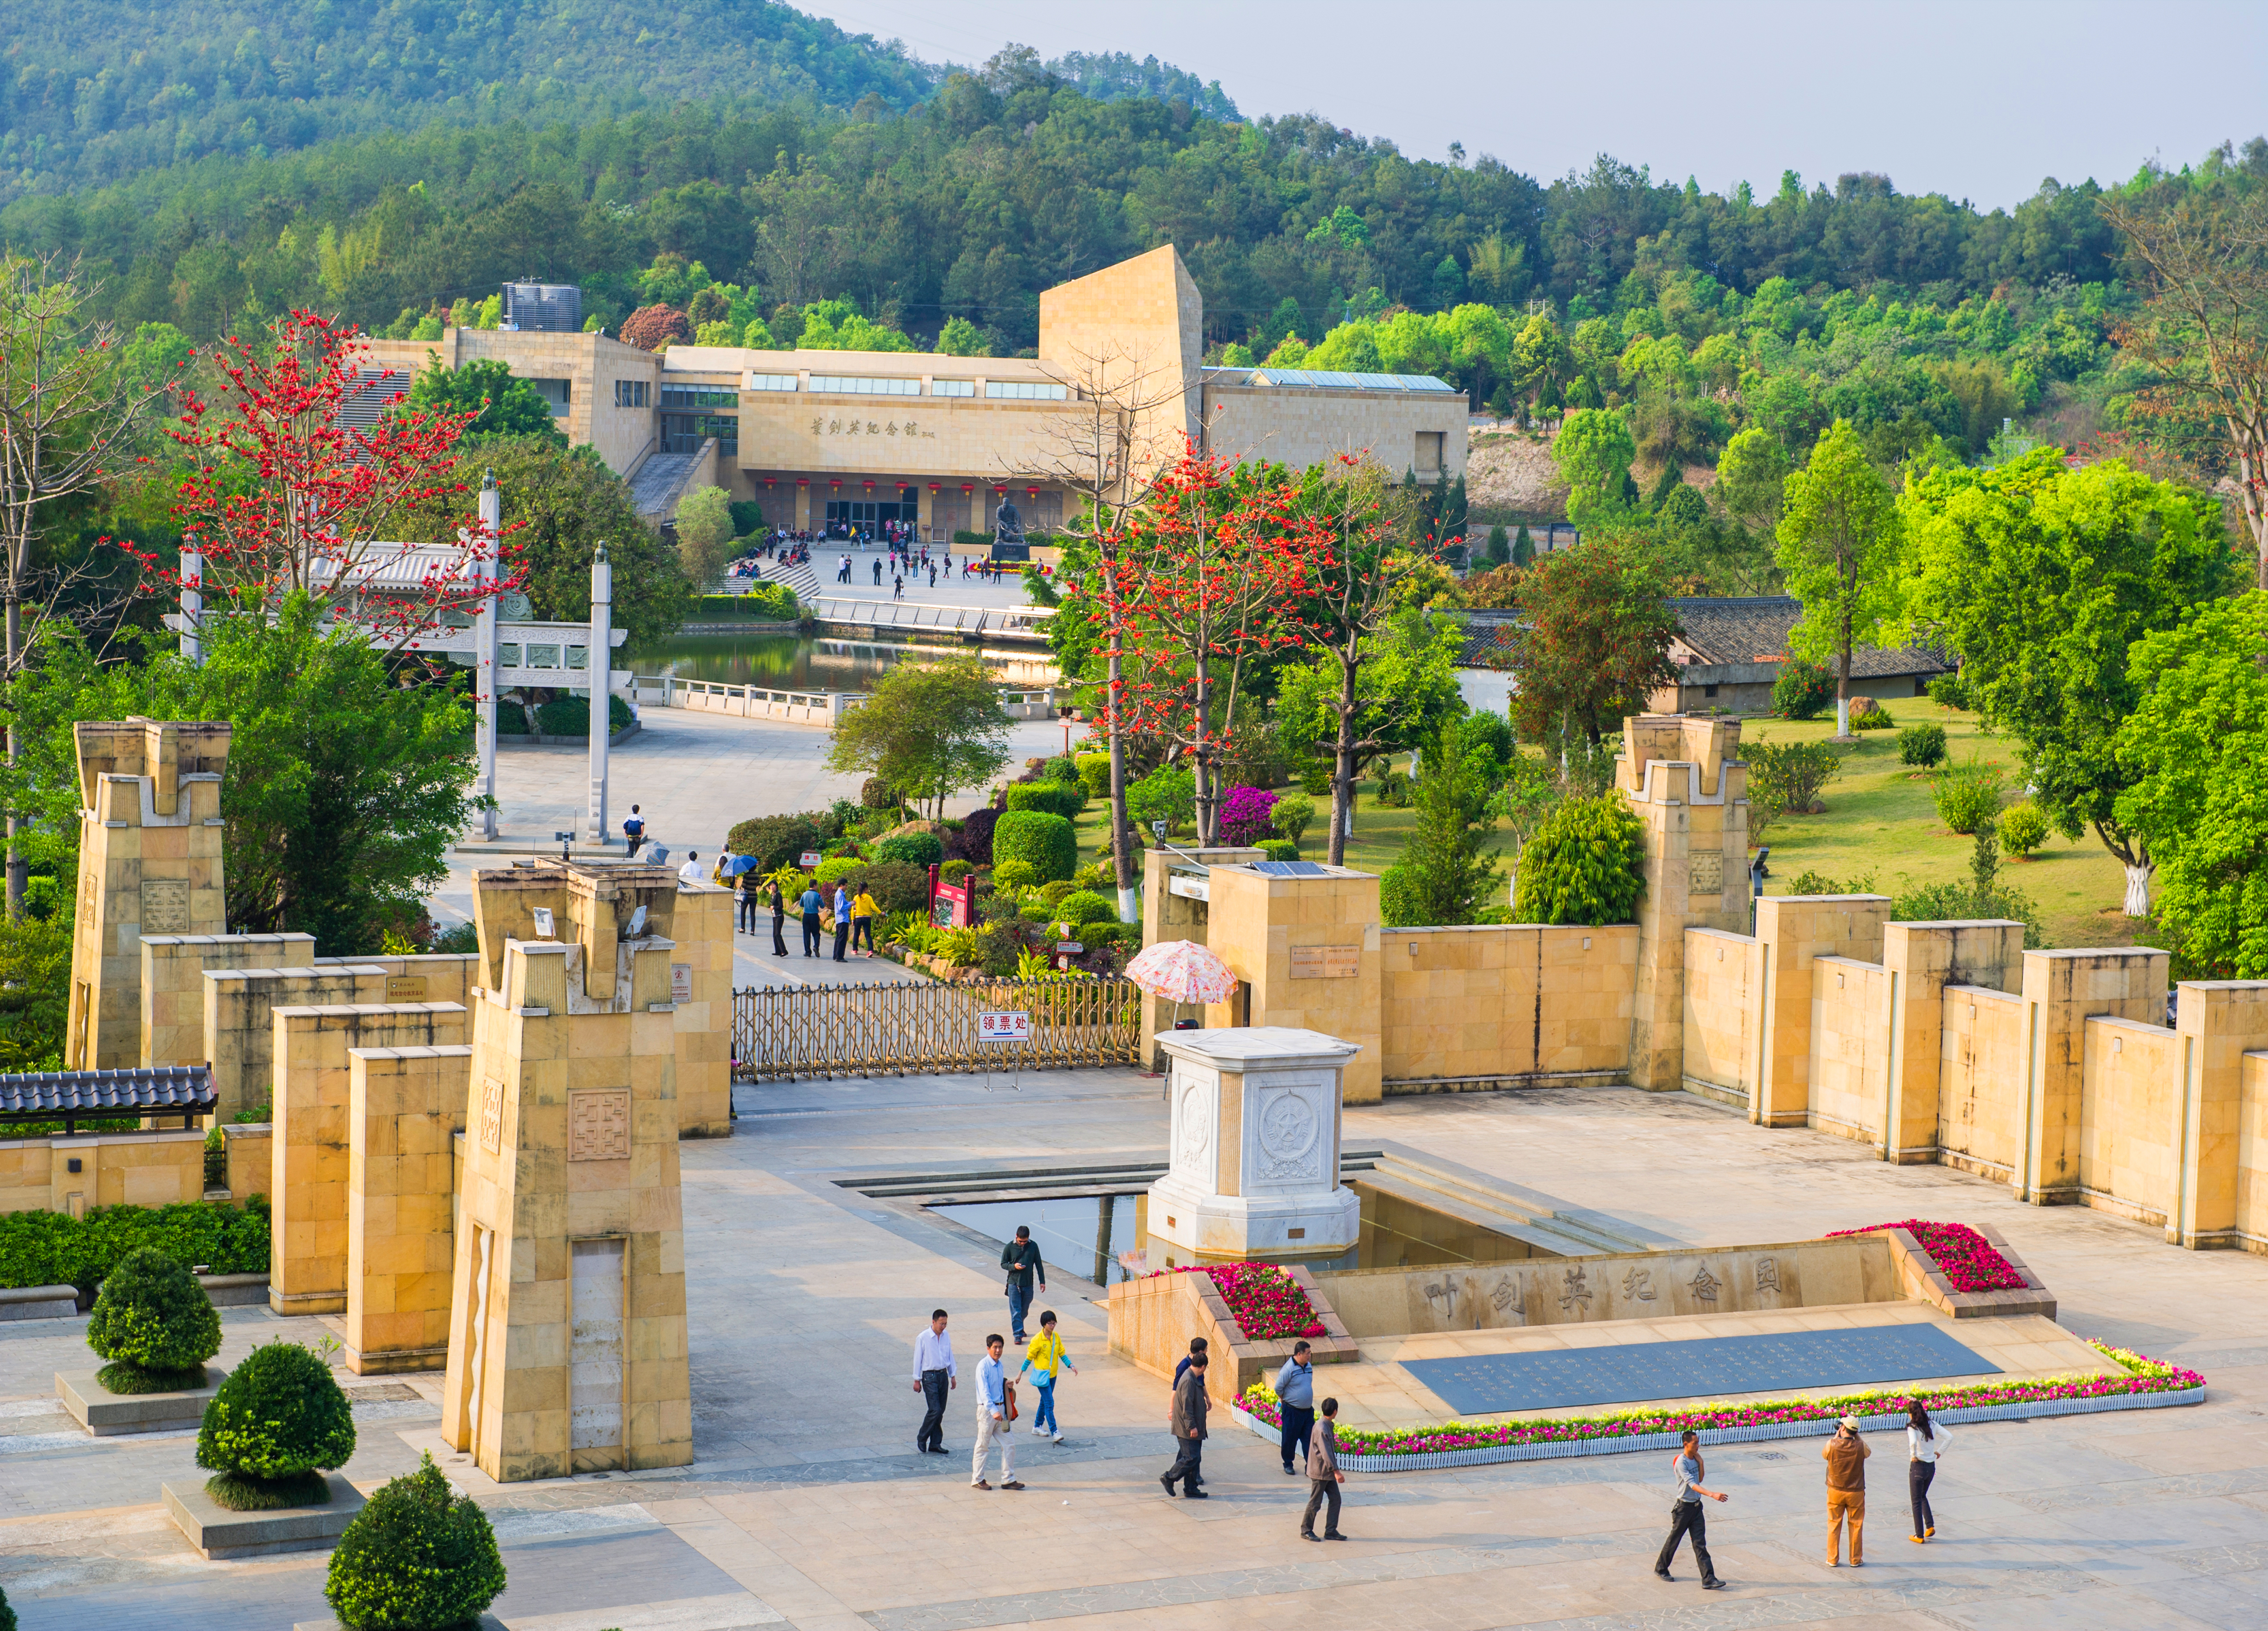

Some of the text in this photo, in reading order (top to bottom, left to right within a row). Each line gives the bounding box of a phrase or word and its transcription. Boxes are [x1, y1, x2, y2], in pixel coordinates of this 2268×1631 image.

[983, 1016, 1026, 1030] 领票处
[1424, 1258, 1781, 1317] 叶剑英纪念园
